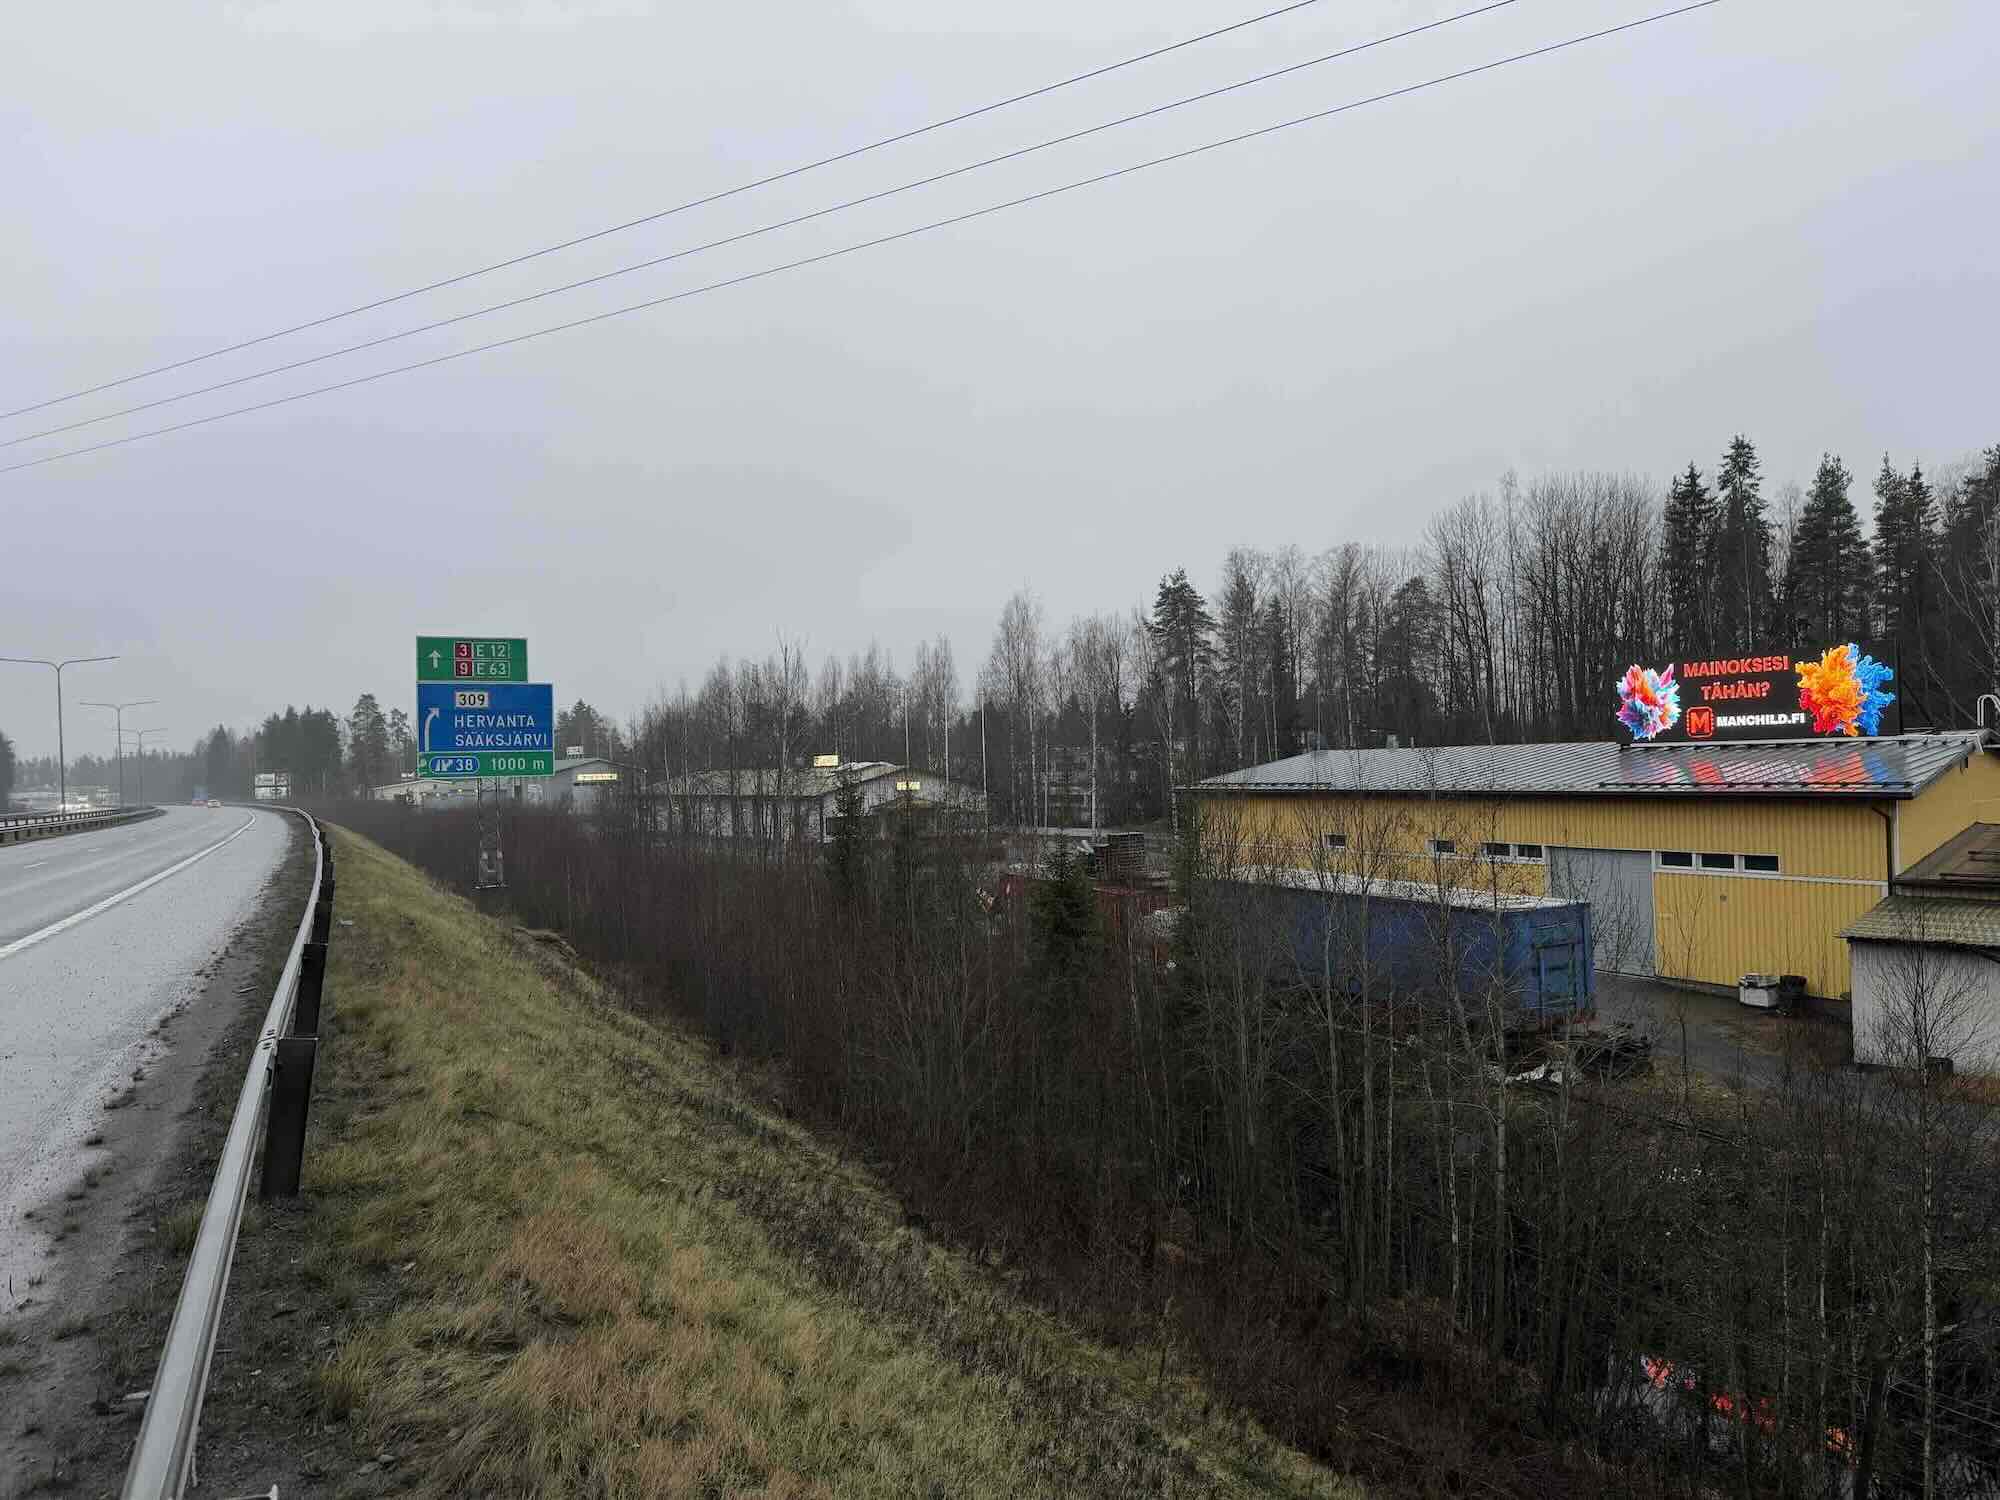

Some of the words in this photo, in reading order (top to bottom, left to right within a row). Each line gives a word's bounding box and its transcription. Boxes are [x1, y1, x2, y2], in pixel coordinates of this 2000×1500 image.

[458, 645, 468, 657] 3
[476, 645, 484, 656] E
[490, 645, 505, 656] 12
[458, 663, 468, 675] 9
[476, 663, 484, 675] E
[489, 663, 506, 675] 63
[1683, 655, 1789, 678] MAINOKSESI
[1701, 681, 1771, 700] TÄHÄN?
[458, 694, 485, 705] 309
[454, 714, 535, 728] HERVANTA
[1690, 711, 1709, 733] M
[1716, 712, 1806, 727] MANCHILD.FI
[455, 731, 547, 747] SÄÄKSJÄRVI
[456, 758, 473, 770] 38
[491, 758, 526, 770] 1000
[532, 760, 545, 770] m
